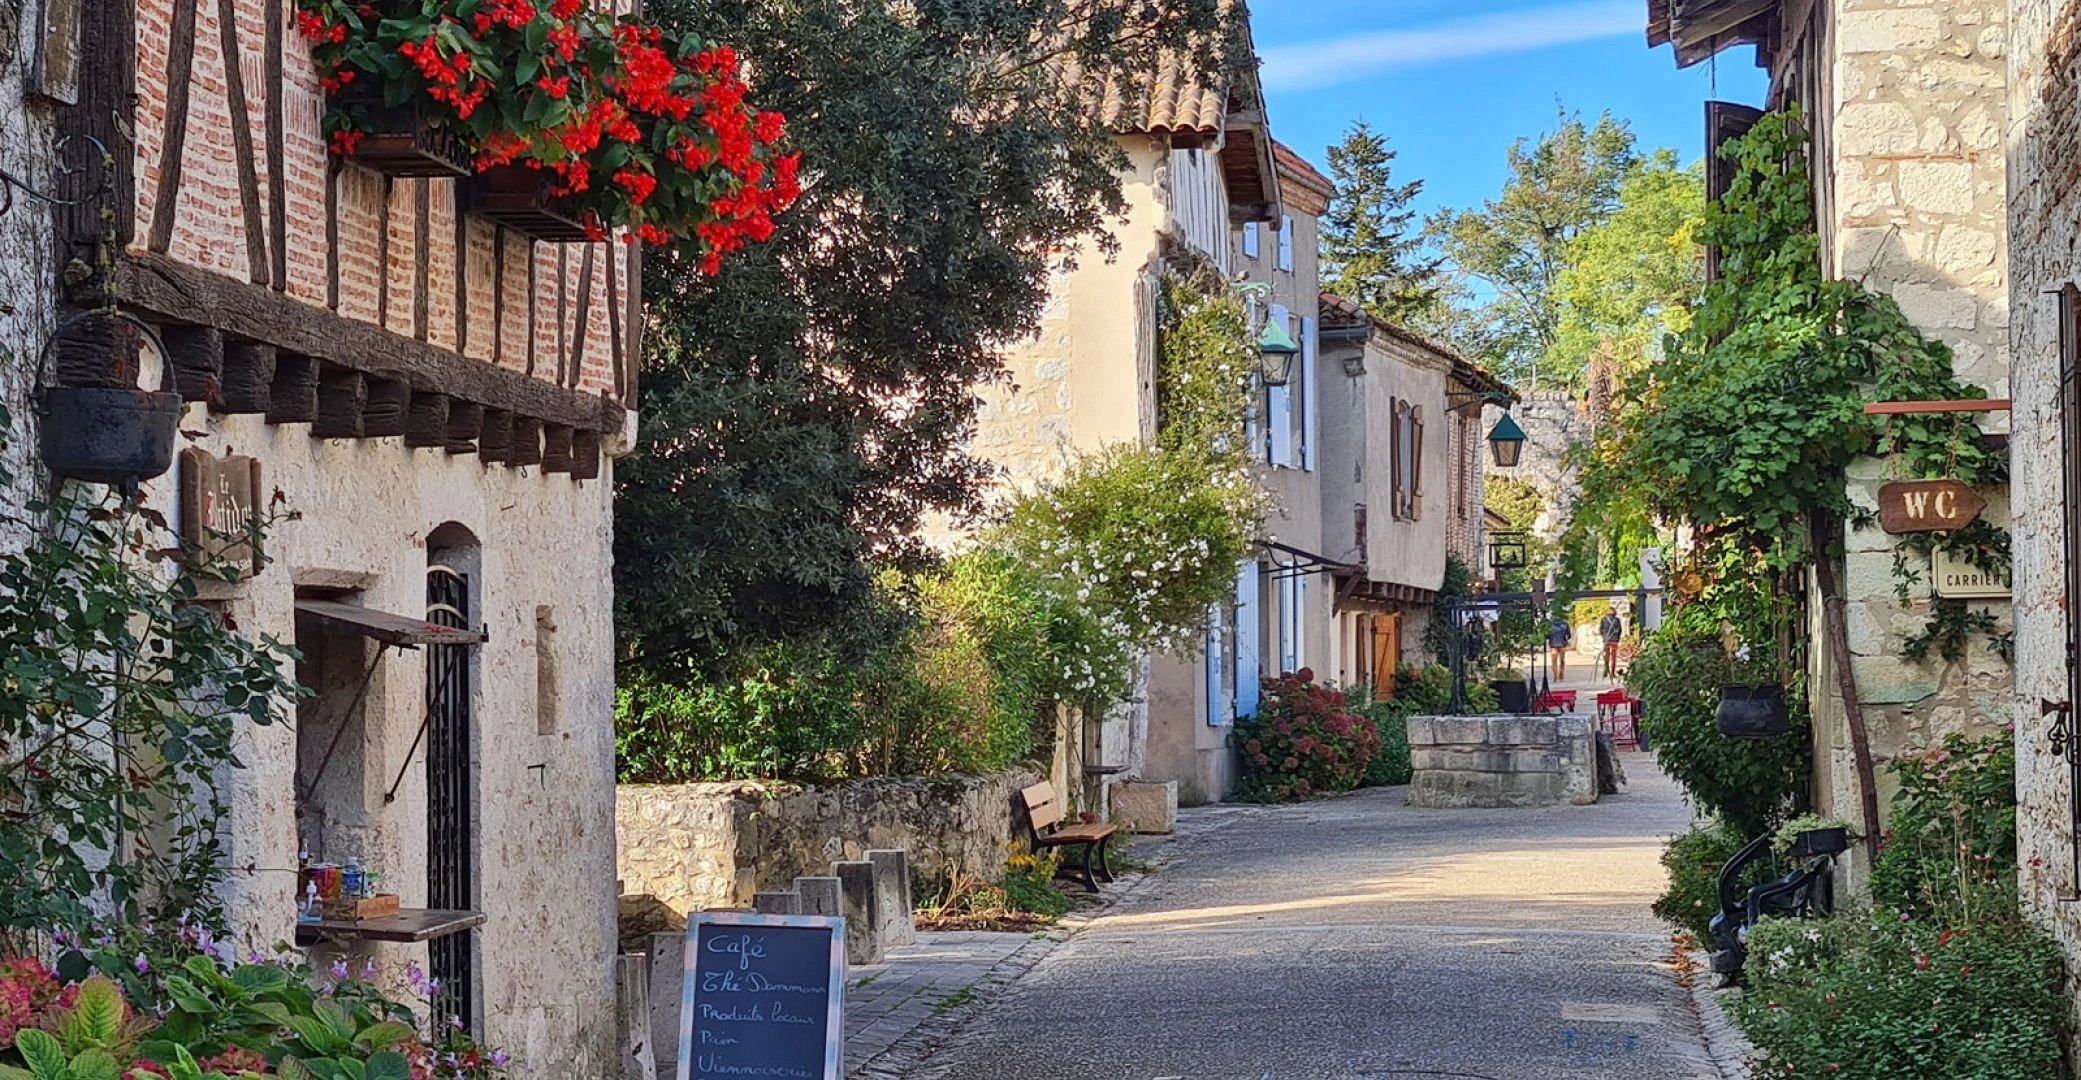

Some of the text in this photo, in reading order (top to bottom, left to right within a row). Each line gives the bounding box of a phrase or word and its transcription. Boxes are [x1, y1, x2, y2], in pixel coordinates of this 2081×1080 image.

[1904, 490, 1956, 519] WC
[1946, 574, 2000, 587] CARRIER
[707, 935, 767, 970] Café
[703, 970, 741, 992] Thé
[700, 1029, 739, 1046] Pain
